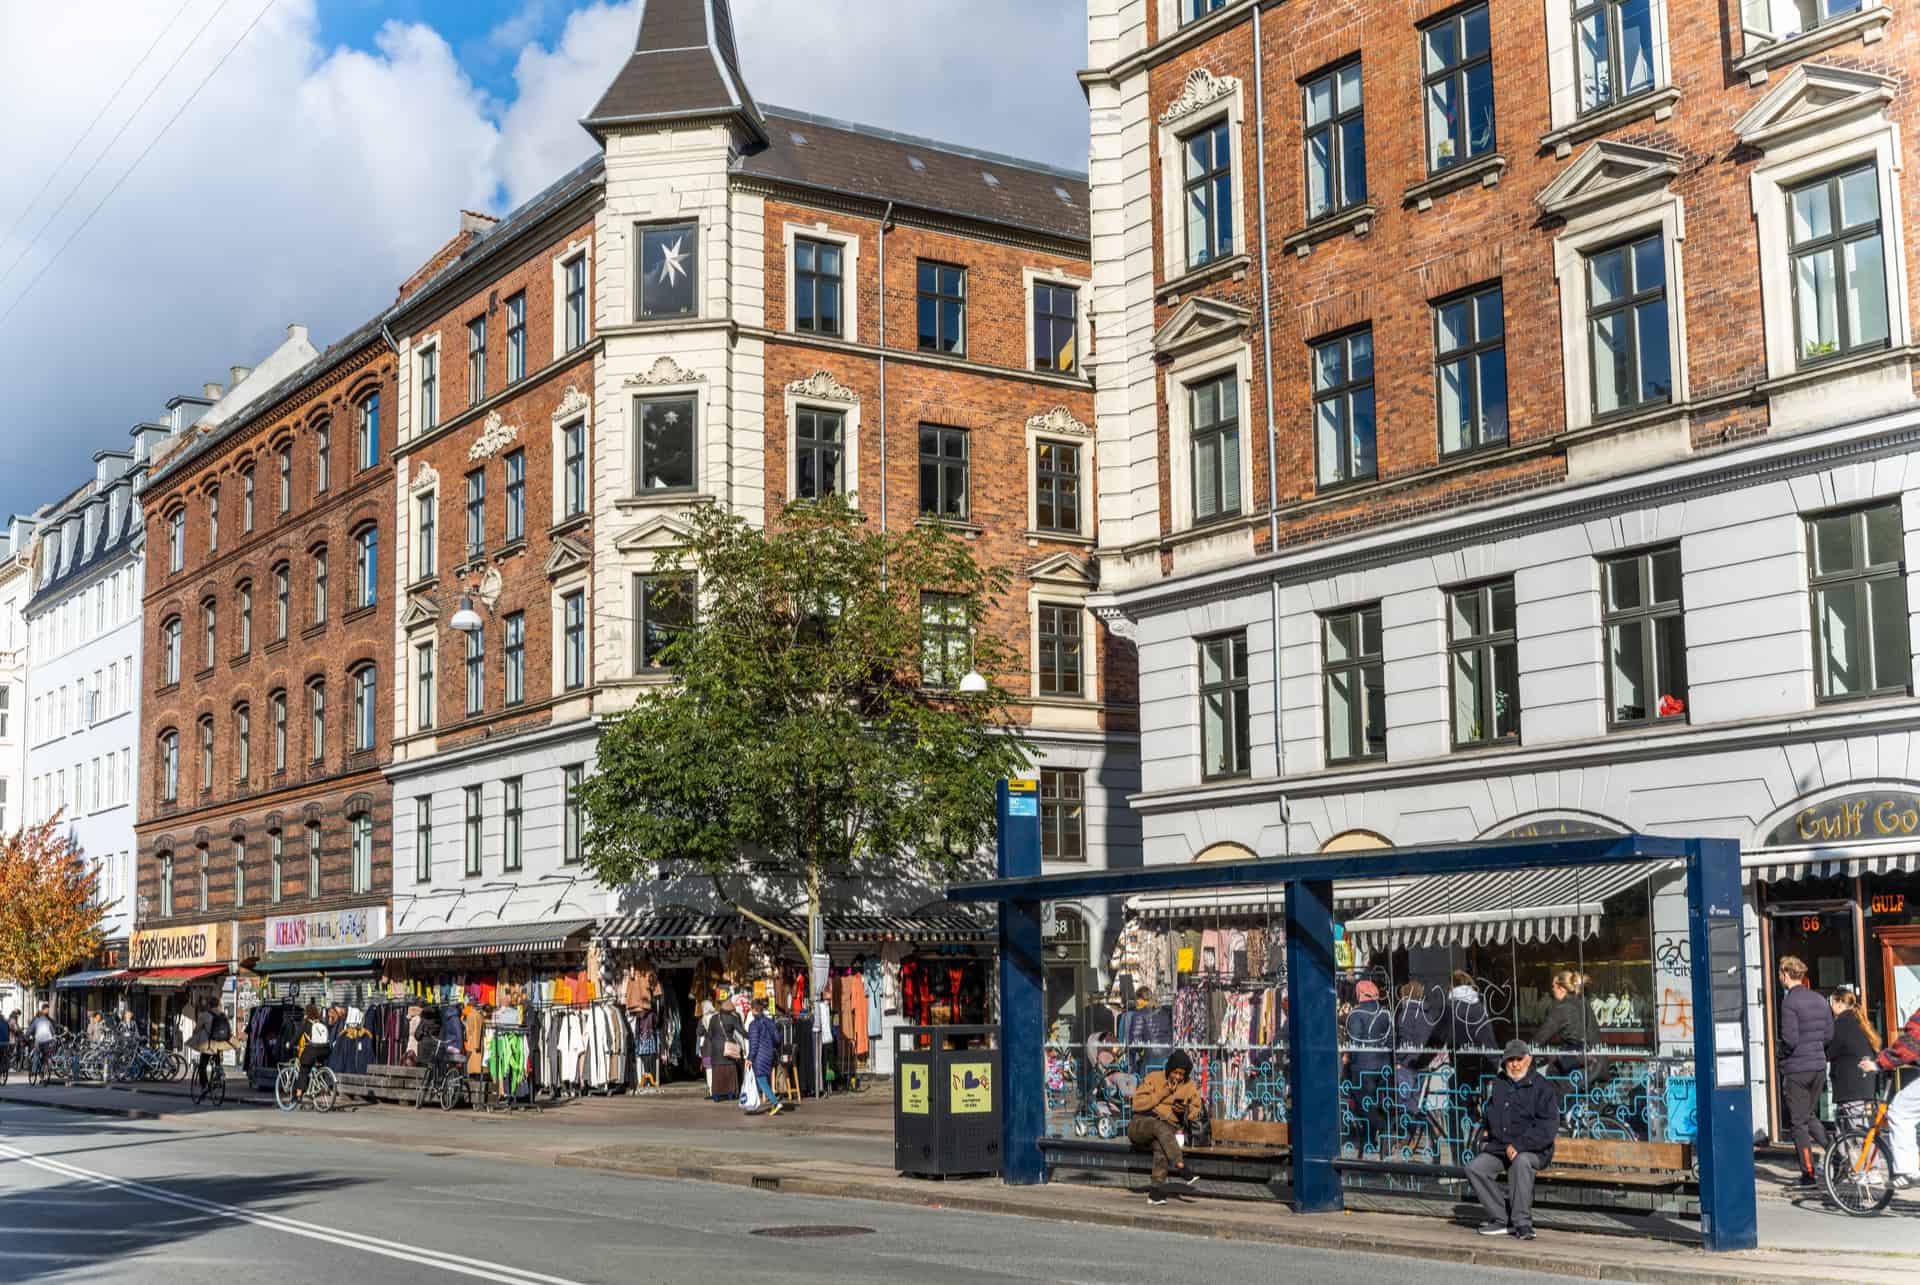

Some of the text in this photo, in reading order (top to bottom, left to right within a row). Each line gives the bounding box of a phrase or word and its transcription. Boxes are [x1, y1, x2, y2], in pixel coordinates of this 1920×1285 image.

[1797, 800, 1867, 840] Gulf
[1872, 894, 1904, 912] GULF
[275, 919, 307, 945] KHAN'S
[1802, 916, 1820, 932] 66
[139, 933, 207, 960] TØRVEMARKED
